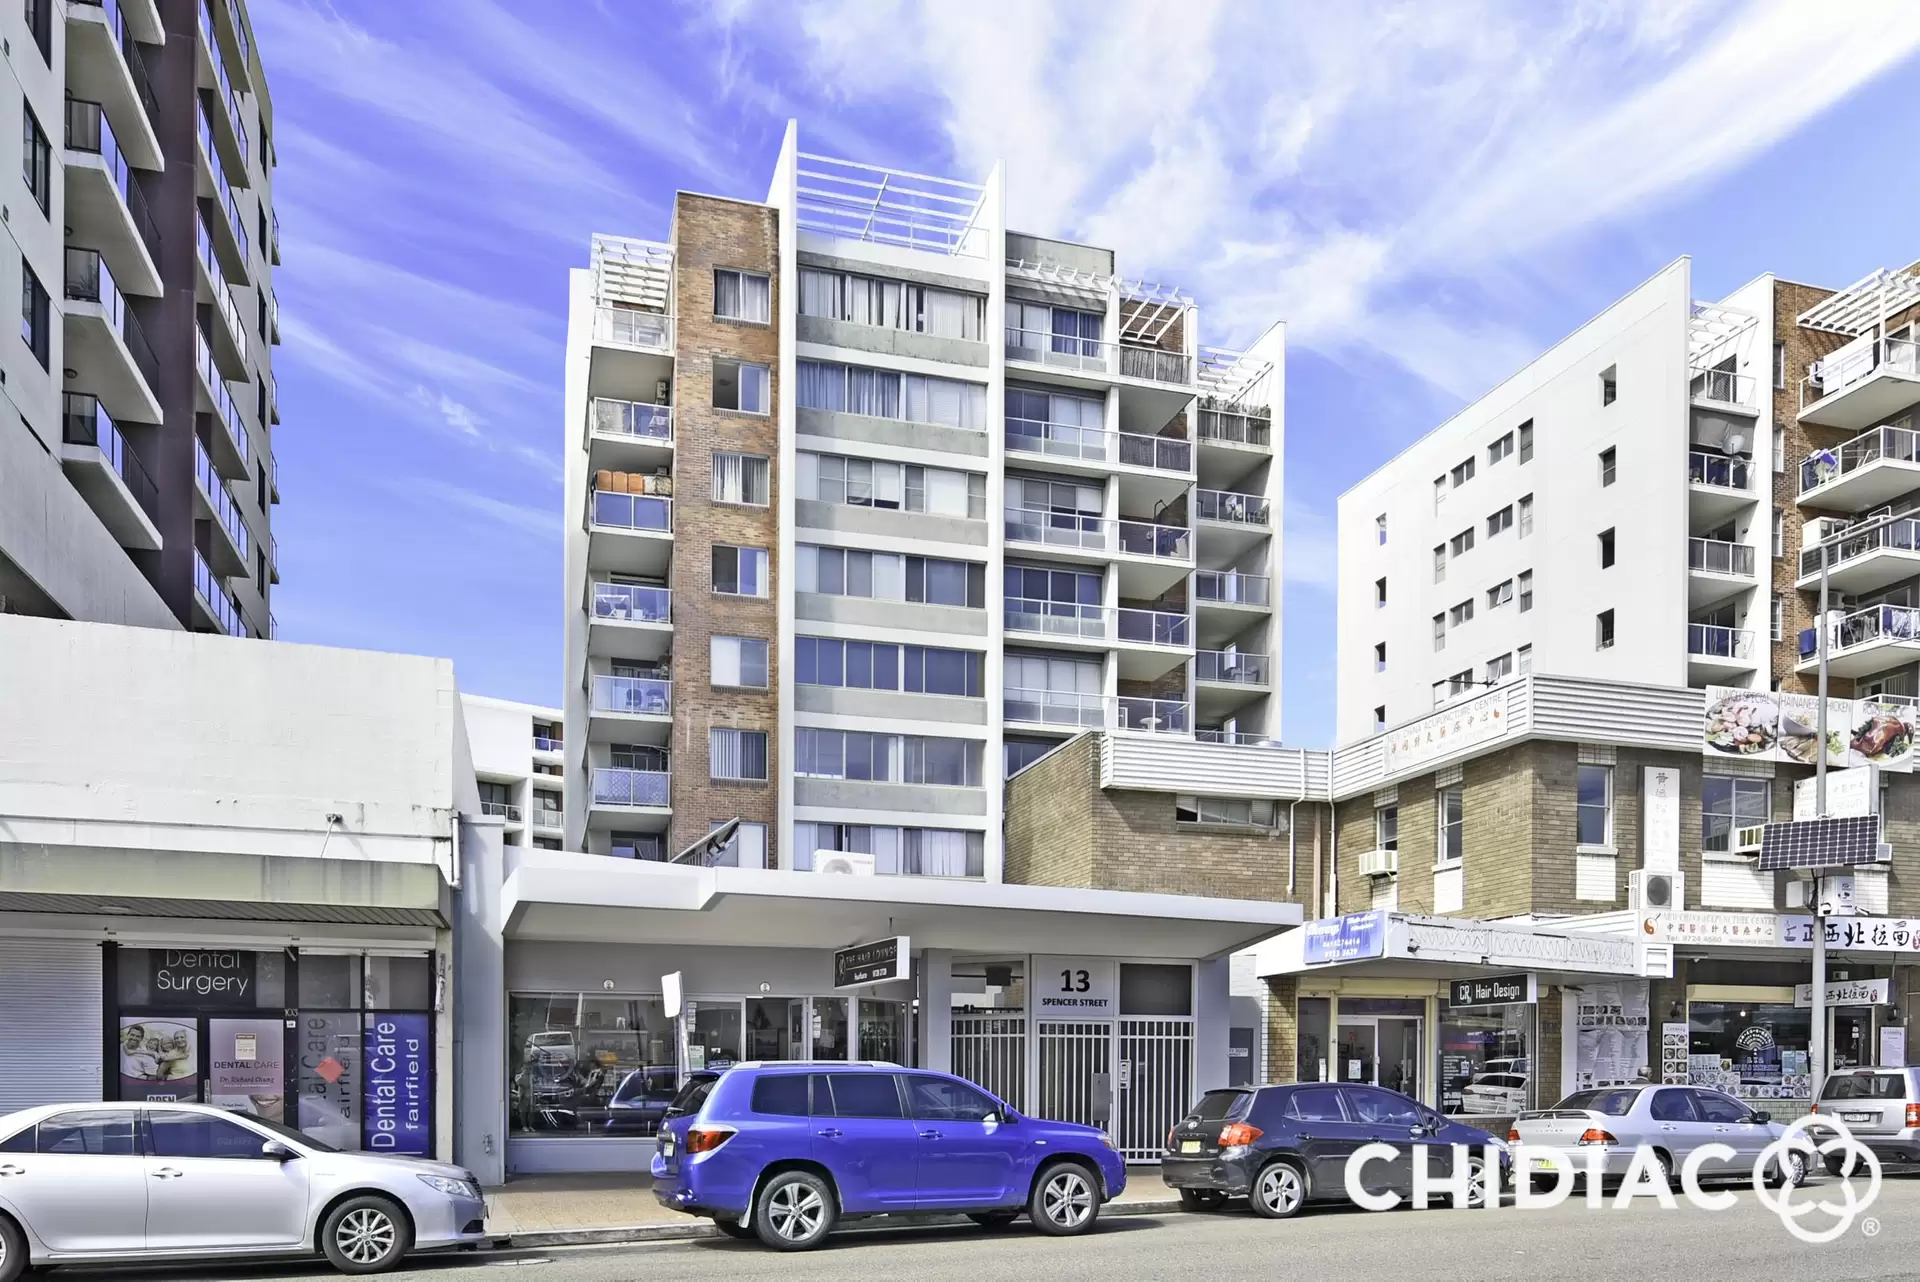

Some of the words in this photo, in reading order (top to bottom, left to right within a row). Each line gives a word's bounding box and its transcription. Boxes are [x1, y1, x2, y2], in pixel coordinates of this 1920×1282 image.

[1474, 693, 1503, 712] CENTRE
[1716, 687, 1742, 702] LUNCH
[166, 950, 240, 969] Dental
[157, 970, 248, 996] Surgery
[1061, 969, 1090, 992] 13
[1475, 984, 1492, 999] Hair
[1493, 982, 1520, 999] Design
[1042, 998, 1078, 1006] SPENCER
[1080, 999, 1108, 1007] STREET
[285, 1008, 299, 1017] 103
[370, 1022, 396, 1073] Care
[214, 1061, 251, 1069] DENTAL
[253, 1061, 280, 1069] CARE
[337, 1036, 351, 1119] airfield
[406, 1039, 419, 1131] fairfield
[371, 1080, 396, 1147] Dental
